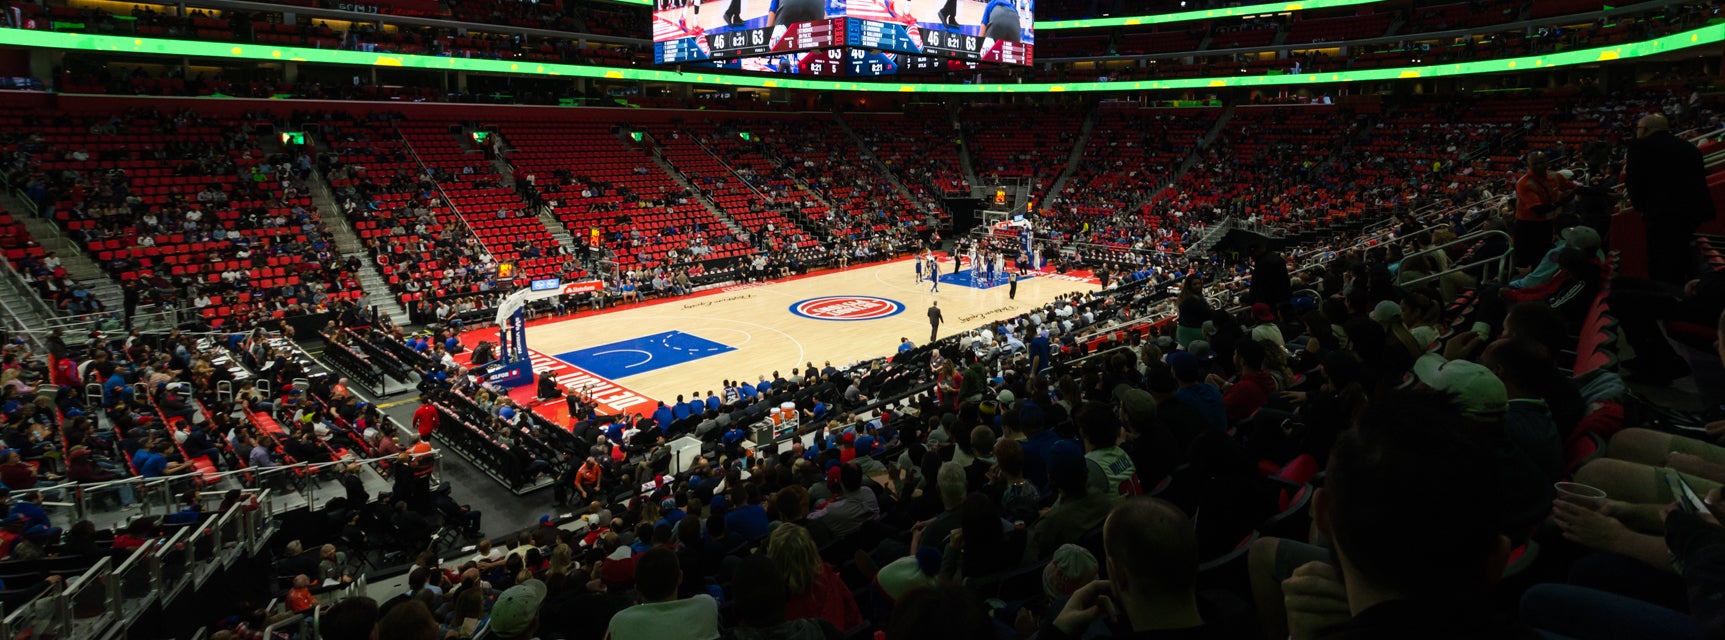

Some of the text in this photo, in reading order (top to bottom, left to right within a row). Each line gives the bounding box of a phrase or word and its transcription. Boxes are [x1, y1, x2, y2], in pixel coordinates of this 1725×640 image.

[713, 34, 725, 49] 46
[732, 36, 745, 47] 8:21
[752, 30, 764, 45] 63
[927, 31, 939, 46] 46
[947, 38, 959, 49] 8:21
[965, 36, 977, 51] 63
[810, 63, 822, 72] 8:21
[871, 63, 883, 72] 8:21
[515, 331, 523, 355] VISION
